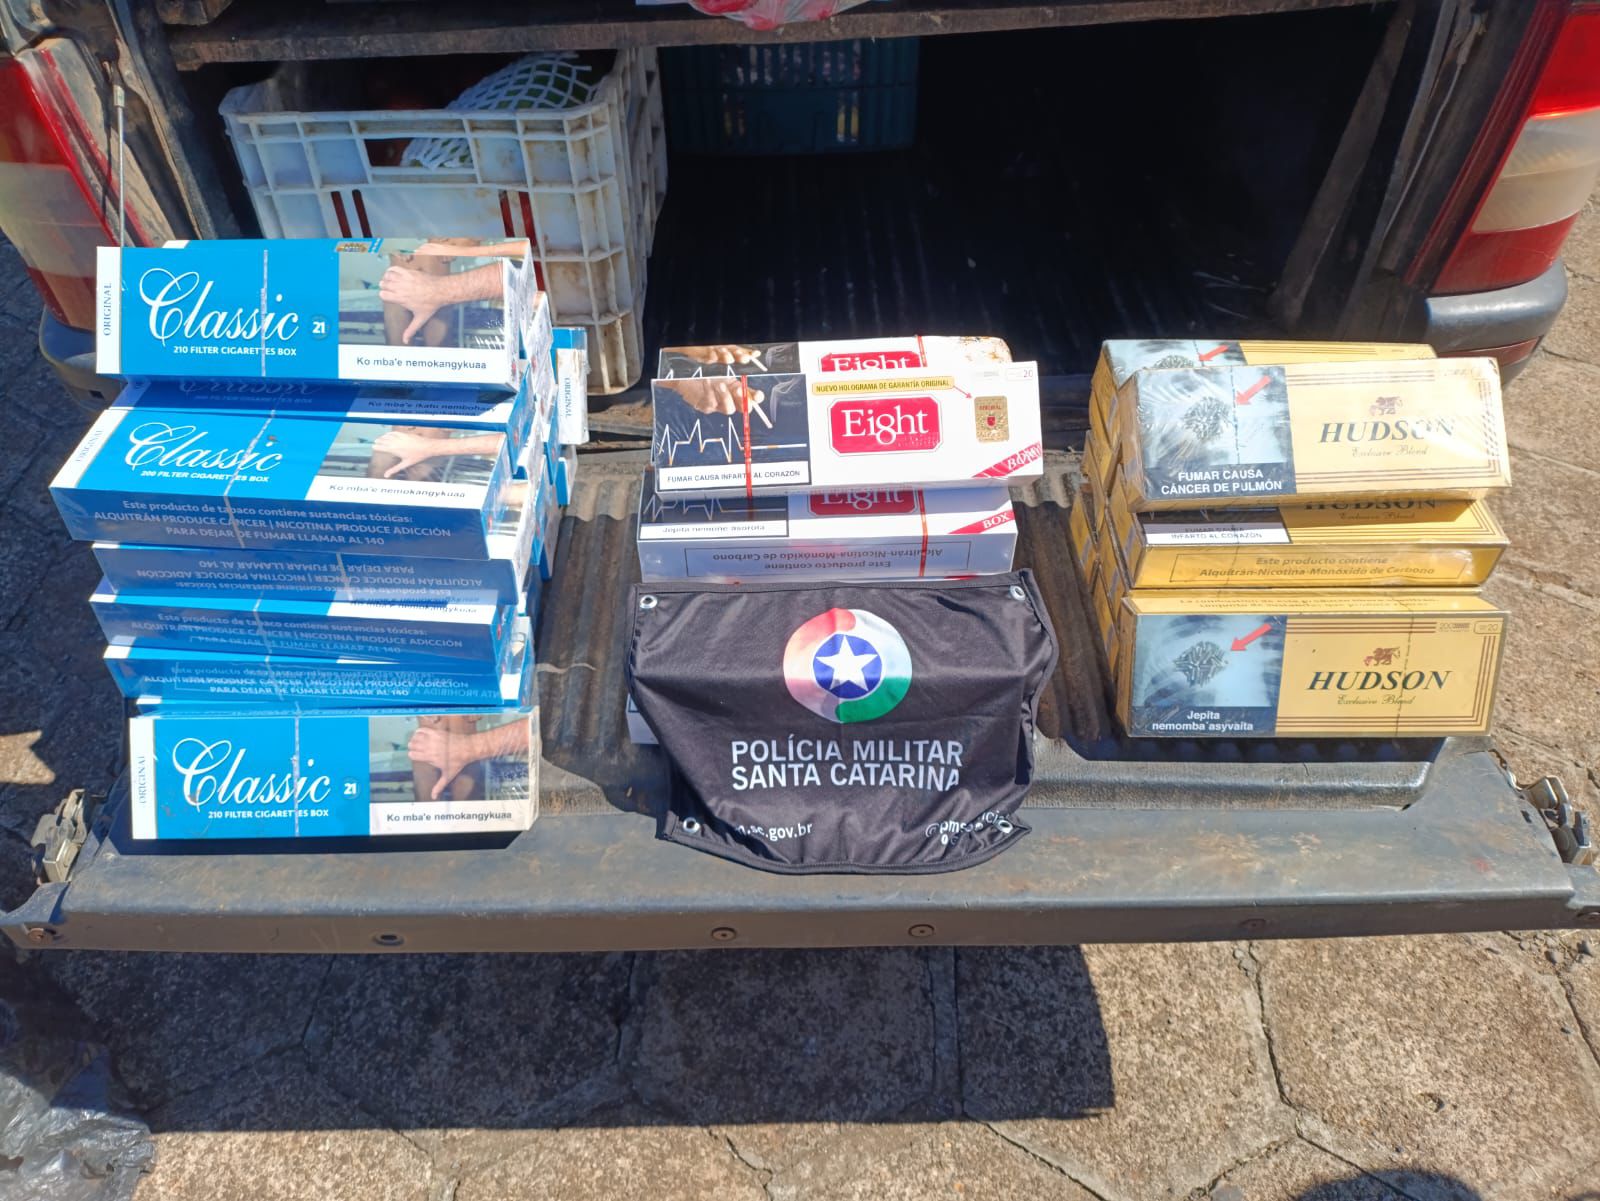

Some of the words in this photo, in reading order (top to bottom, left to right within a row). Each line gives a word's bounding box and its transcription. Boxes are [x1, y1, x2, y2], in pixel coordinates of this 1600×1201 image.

[103, 283, 112, 336] ORIGINAL
[139, 267, 299, 347] Classic
[312, 321, 326, 335] 21
[173, 345, 189, 354] 210
[190, 346, 219, 355] FILTER
[221, 346, 276, 356] CIGARETES
[277, 347, 297, 356] BOX
[356, 357, 371, 366] Ko
[373, 357, 403, 367] mba'e
[405, 359, 487, 371] nemokangykuaa
[816, 384, 838, 392] NUEVO
[838, 383, 878, 391] HOLOGRAMA
[920, 379, 950, 388] ORIGINAL
[564, 377, 572, 417] ORIGINAL
[841, 405, 929, 445] Eight
[1318, 417, 1456, 444] HUDSON
[124, 422, 283, 471] Classic
[157, 471, 189, 479] FILTER
[190, 472, 247, 481] CIGARETES
[667, 475, 693, 483] FUMAR
[694, 474, 720, 482] CAUSA
[721, 472, 751, 480] INFART
[1178, 470, 1219, 482] FUMAR
[1222, 468, 1263, 480] CAUSA
[380, 487, 466, 498] nemokangykuaa
[1161, 483, 1210, 496] CÁNCER
[1212, 483, 1230, 494] DE
[1232, 478, 1283, 492] PULMÓN
[123, 500, 147, 509] Este
[149, 502, 199, 514] producto
[201, 504, 216, 513] de
[258, 508, 308, 518] contiene
[309, 510, 368, 521] sustancias
[369, 512, 413, 523] tóxicas:
[94, 511, 161, 523] ALQUITRÁN
[162, 516, 217, 526] PRODUCE
[275, 520, 333, 532] NICOTINA
[335, 523, 390, 534] PRODUCE
[393, 526, 451, 537] ADICCIÓN
[982, 512, 1010, 529] BOX
[165, 526, 198, 536] PARA
[199, 528, 234, 538] DEJAR
[237, 530, 253, 539] DE
[254, 531, 296, 541] FUMAR
[298, 532, 345, 544] LLAMAR
[348, 536, 363, 545] AL
[365, 537, 385, 545] 140
[713, 553, 760, 561] Carbono
[1256, 557, 1281, 565] Este
[1282, 557, 1336, 567] producto
[1338, 556, 1388, 565] contiene
[199, 560, 219, 568] 140
[237, 561, 285, 571] LLAMAR
[286, 563, 328, 571] FUMAR
[346, 564, 382, 574] DEJAR
[384, 565, 415, 574] PARA
[764, 562, 812, 570] contiene
[814, 560, 867, 570] producto
[1369, 566, 1385, 575] de
[1386, 565, 1436, 575] Carbono
[195, 571, 249, 580] PRODUCE
[252, 572, 307, 582] NICOTINA
[364, 576, 416, 585] PRODUCE
[157, 613, 180, 622] Este
[182, 615, 230, 626] producto
[231, 617, 244, 625] de
[284, 620, 329, 631] contiene
[330, 624, 386, 634] sustancias
[299, 630, 353, 642] NICOTINA
[355, 635, 407, 645] PRODUCE
[1307, 670, 1452, 690] HUDSON
[209, 686, 240, 694] PARA
[241, 686, 273, 695] DEJAR
[289, 687, 329, 696] FUMAR
[1187, 710, 1221, 721] Jepita
[730, 734, 841, 764] POLÍCIA
[852, 739, 964, 768] MILITAR
[137, 755, 146, 804] ORIGINAL
[172, 737, 331, 813] Classic
[731, 763, 822, 791] SANTA
[830, 763, 961, 792] CATARINA
[343, 782, 357, 795] 21
[208, 810, 223, 819] 210
[224, 810, 252, 819] FILTER
[254, 809, 309, 819] CIGARETES
[310, 808, 329, 817] BOX
[386, 813, 401, 822] Ko
[402, 812, 432, 822] mba'e
[434, 811, 512, 821] nemokangykuaa
